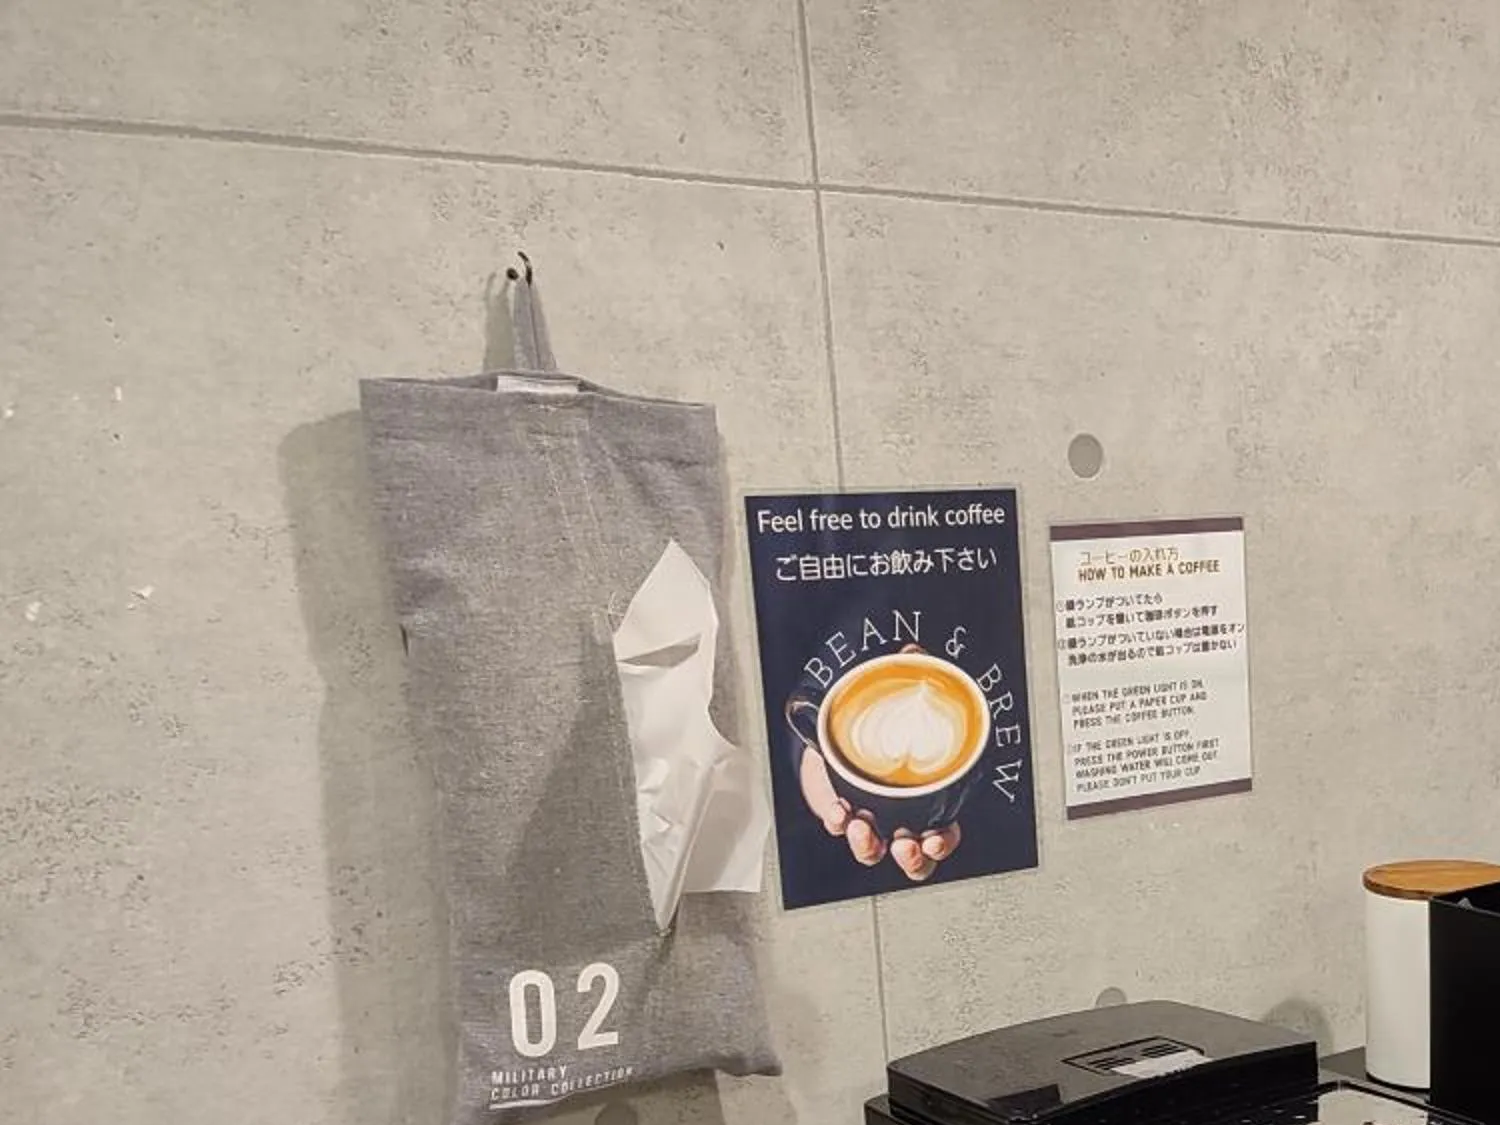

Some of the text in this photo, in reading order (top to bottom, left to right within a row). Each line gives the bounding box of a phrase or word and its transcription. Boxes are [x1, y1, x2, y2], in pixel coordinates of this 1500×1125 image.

[757, 503, 1006, 533] Feel free to drink coffee
[775, 547, 997, 581] ご自由にお飲み下さい
[1077, 559, 1221, 582] HOW TO MAKE A COFFEE
[1103, 687, 1119, 700] THE
[1121, 684, 1150, 697] GREEN
[1154, 681, 1176, 693] LIGHT
[803, 609, 1024, 804] BEAN & BREW
[1072, 702, 1105, 716] PLEASE
[1110, 700, 1125, 712] PUT
[1139, 695, 1166, 708] PAPER
[1170, 693, 1186, 705] CUP
[1073, 716, 1102, 730] PRESS
[1105, 714, 1121, 726] THE
[1125, 710, 1158, 723] COFFEE
[1074, 753, 1102, 767] PRESS
[1107, 751, 1122, 763] THE
[1126, 747, 1158, 761] POWER
[1161, 742, 1194, 755] BUTTON
[1105, 736, 1133, 750] GREEN
[1121, 760, 1150, 773] WATER
[1076, 778, 1110, 793] PLEASE
[509, 961, 620, 1057] 02
[491, 1065, 567, 1085] MILITARY
[491, 1066, 633, 1101] COLOR COLLECTION
